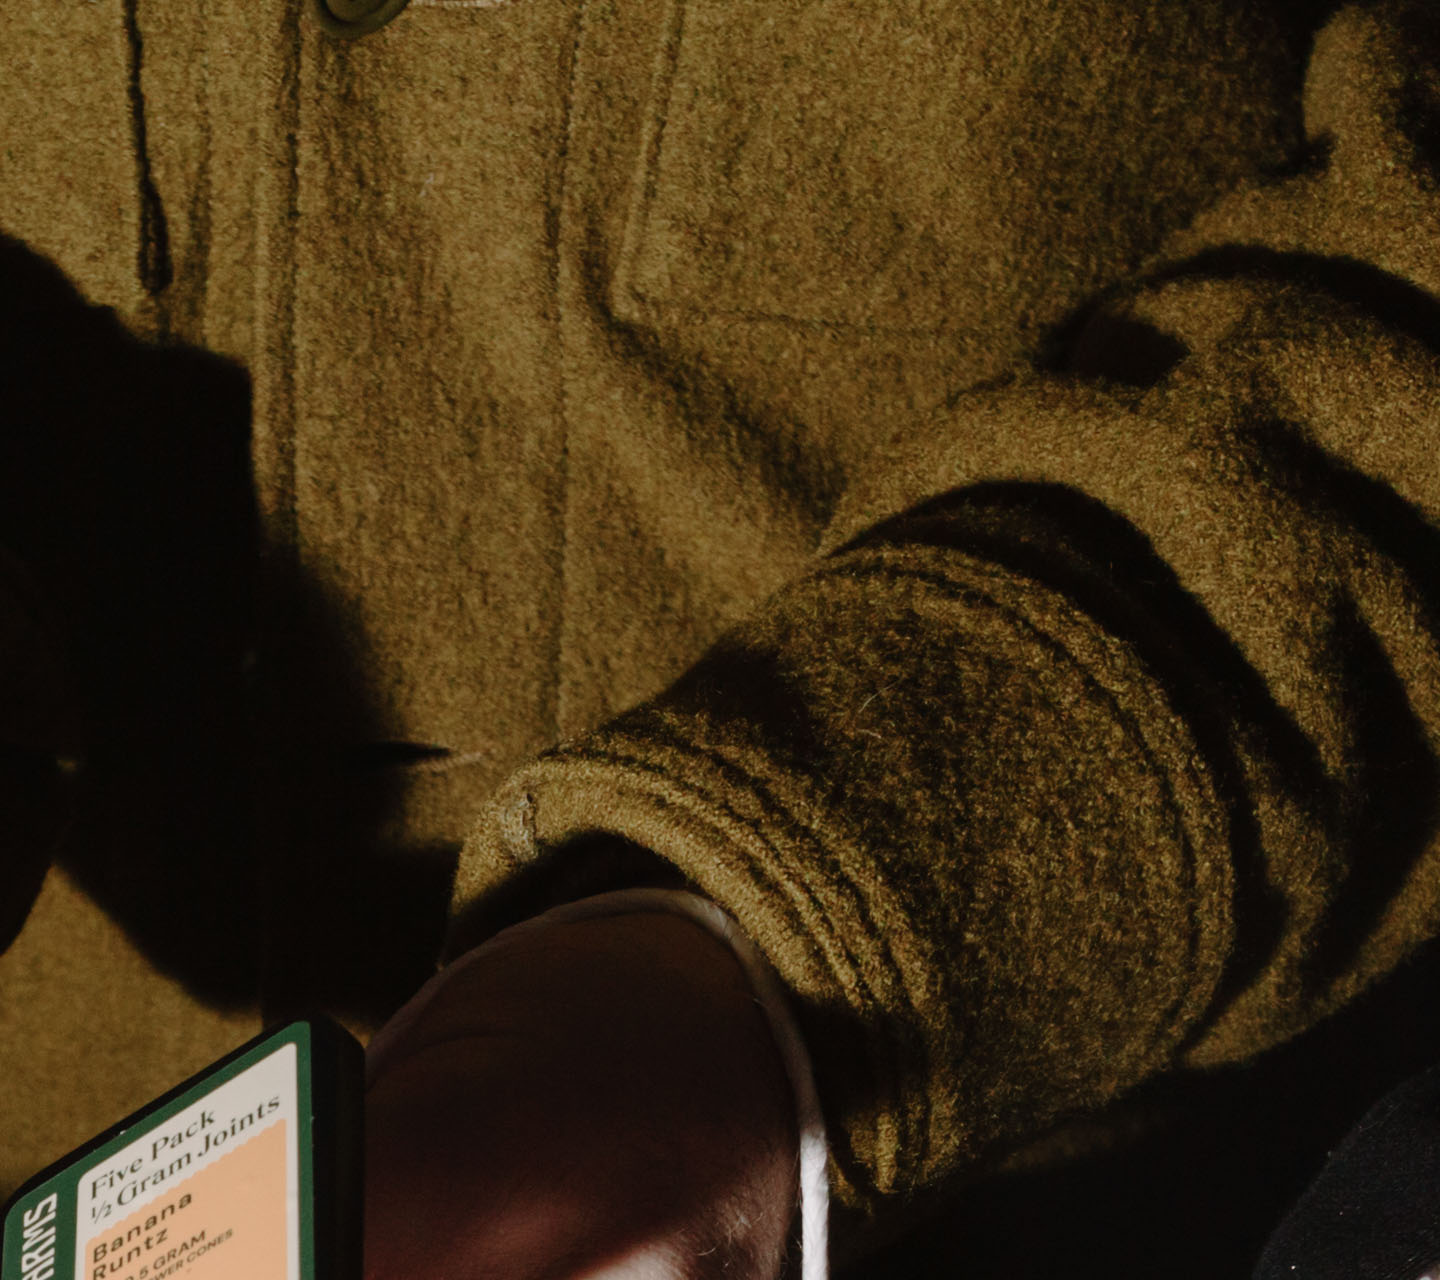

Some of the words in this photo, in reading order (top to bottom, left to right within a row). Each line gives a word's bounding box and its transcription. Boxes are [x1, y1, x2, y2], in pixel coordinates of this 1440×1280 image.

[91, 1156, 143, 1200] Five
[151, 1109, 216, 1161] Pack
[116, 1151, 192, 1207] Gram
[196, 1095, 281, 1159] Joints
[92, 1193, 193, 1265] Banana
[152, 1229, 207, 1271] GRAM
[185, 1228, 234, 1264] CONES
